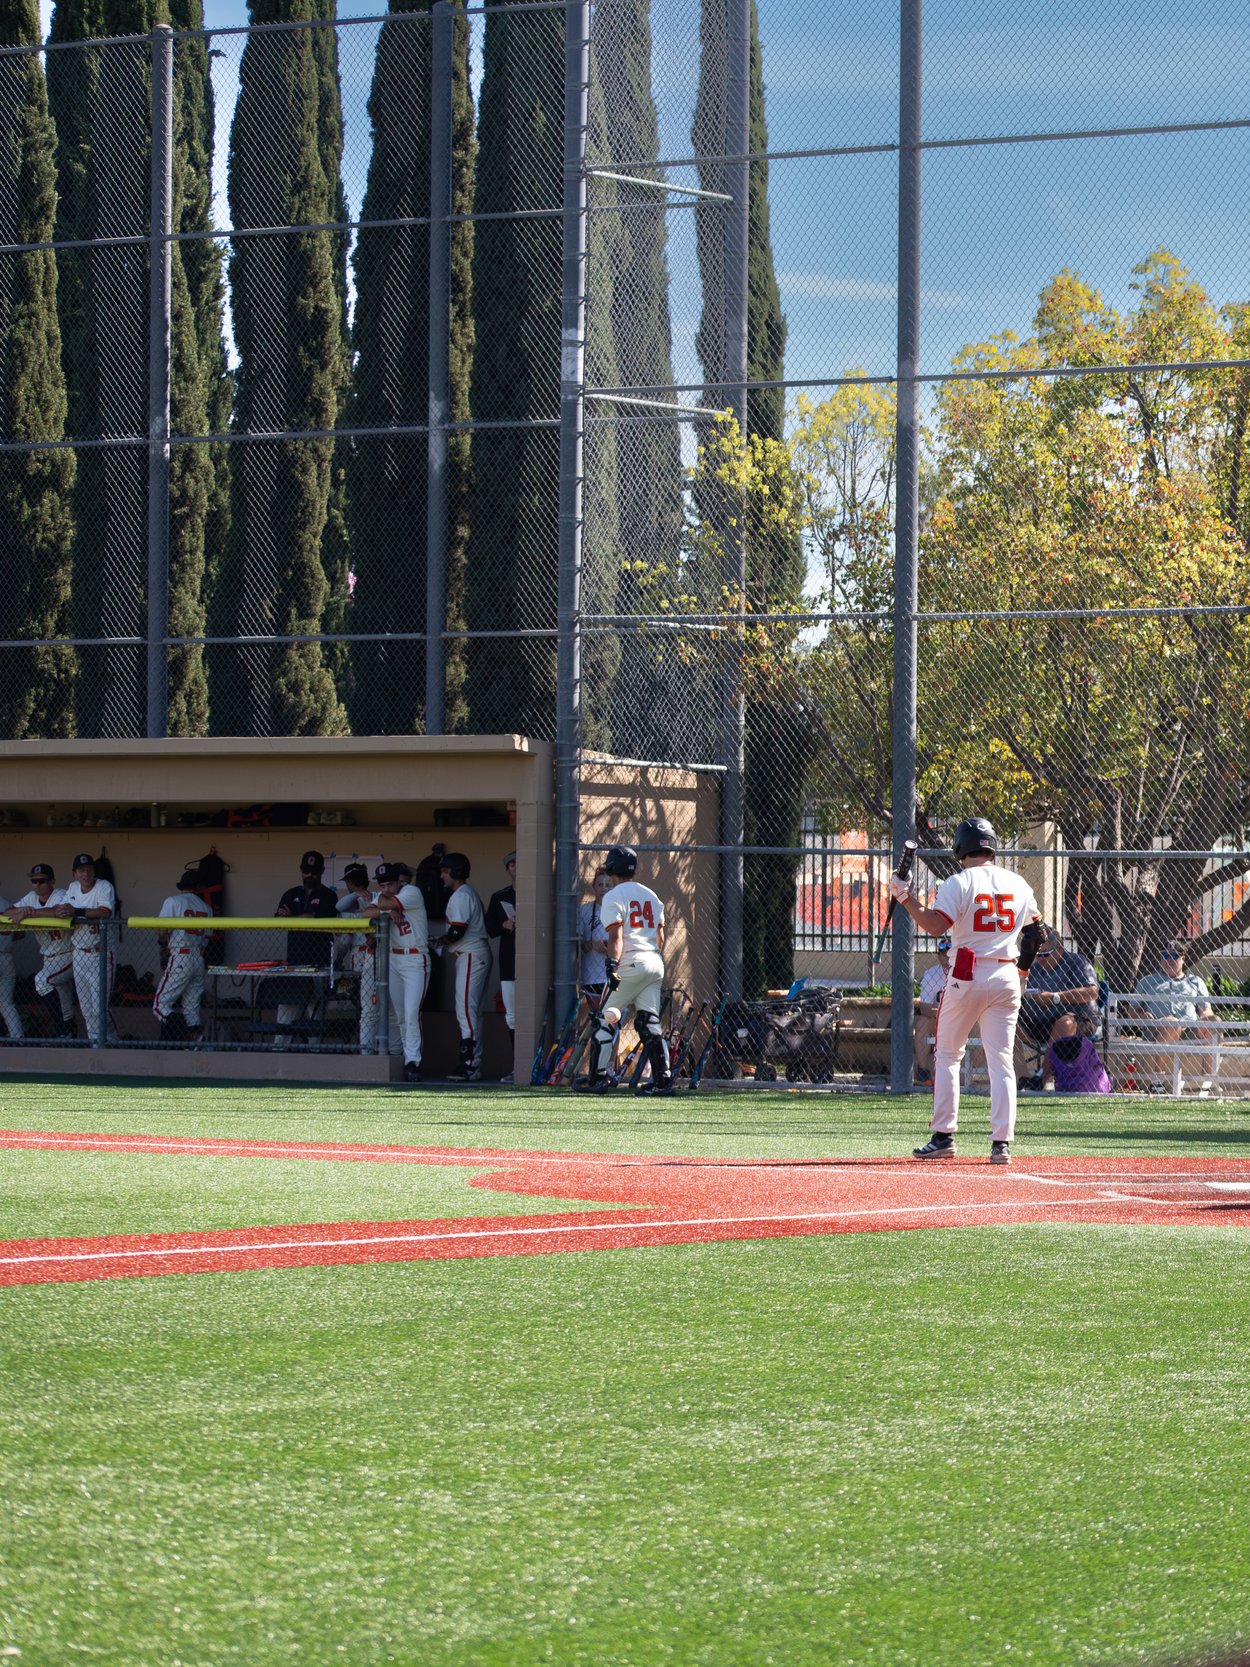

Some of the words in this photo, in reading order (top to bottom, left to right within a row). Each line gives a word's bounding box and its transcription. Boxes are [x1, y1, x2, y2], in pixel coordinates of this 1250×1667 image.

[629, 900, 655, 929] 24
[972, 892, 1015, 933] 25
[399, 921, 413, 936] 12
